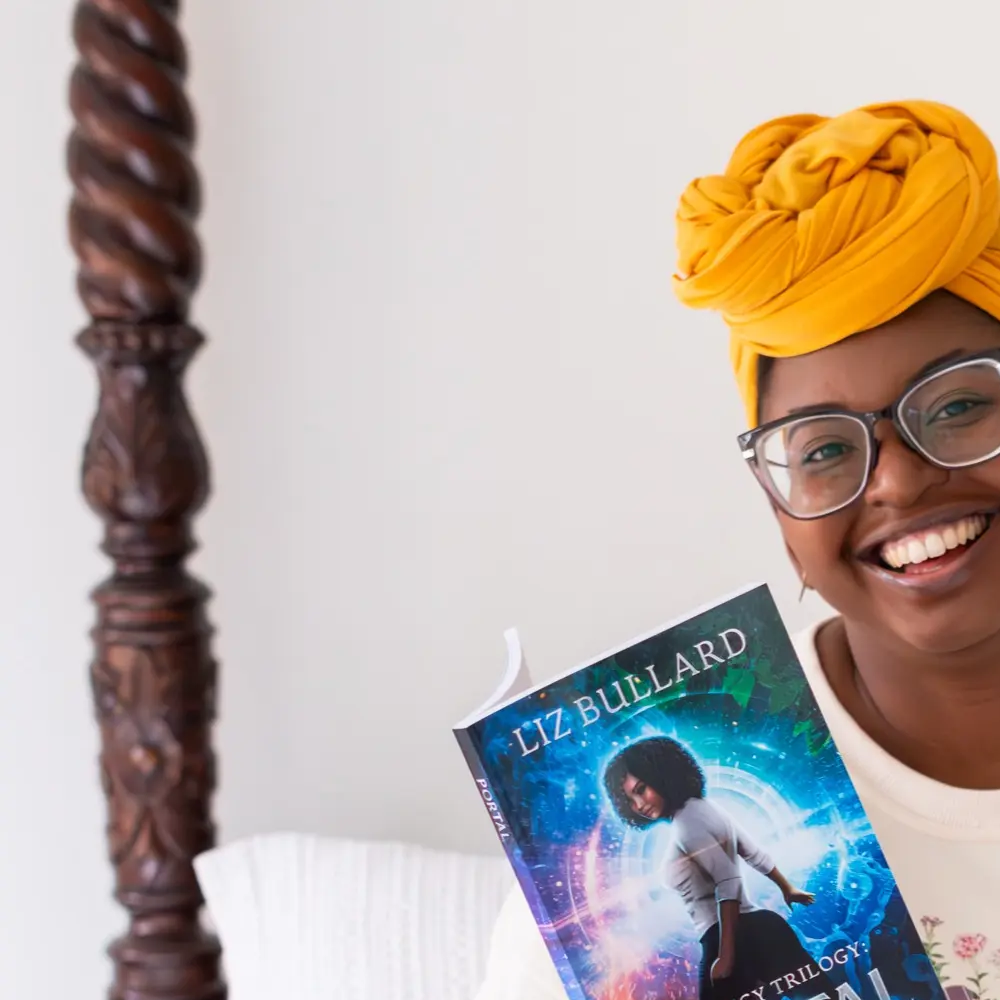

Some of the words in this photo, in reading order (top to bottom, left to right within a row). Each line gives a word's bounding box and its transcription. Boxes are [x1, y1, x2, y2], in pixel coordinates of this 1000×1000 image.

[513, 709, 571, 757] LIZ
[574, 626, 748, 727] BULLARD
[476, 778, 510, 842] PORTAL
[770, 942, 869, 1000] TRILOGY:
